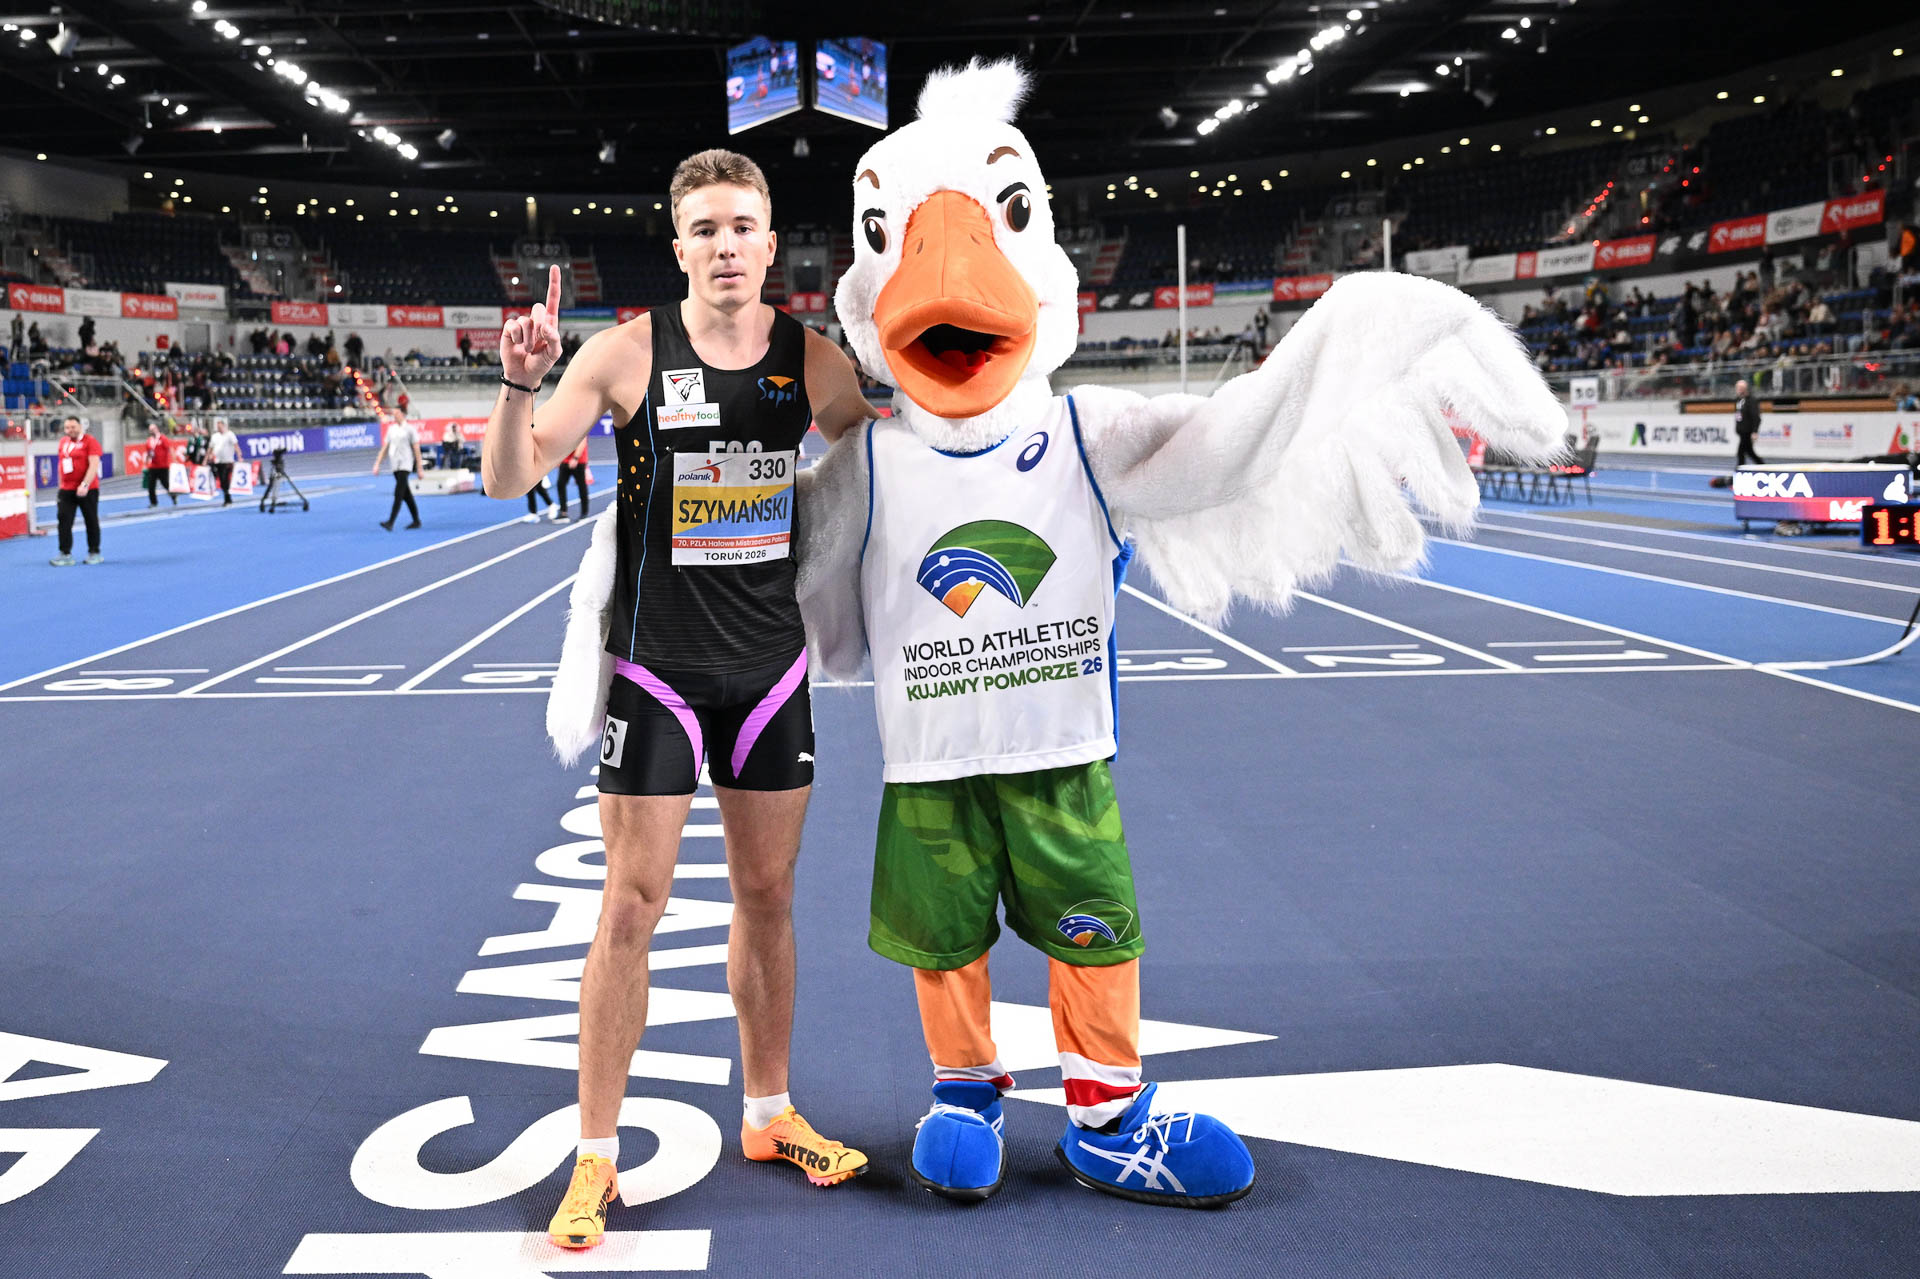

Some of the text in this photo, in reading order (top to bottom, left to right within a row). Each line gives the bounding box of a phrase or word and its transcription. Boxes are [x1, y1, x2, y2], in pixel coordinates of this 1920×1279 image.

[198, 473, 207, 491] 2
[236, 469, 248, 487] 3
[678, 472, 711, 482] polanik
[749, 457, 786, 480] 330
[678, 494, 788, 524] SZYMAŃSKI
[705, 549, 767, 561] TORUŃ 2026
[902, 616, 1099, 663] WORLD ATHLETICS
[904, 638, 1101, 681] INDOOR CHAMPIONSHIPS
[906, 656, 1103, 701] KUJAWY POMORZE 26
[602, 720, 618, 760] 6
[773, 1138, 831, 1173] NITRO
